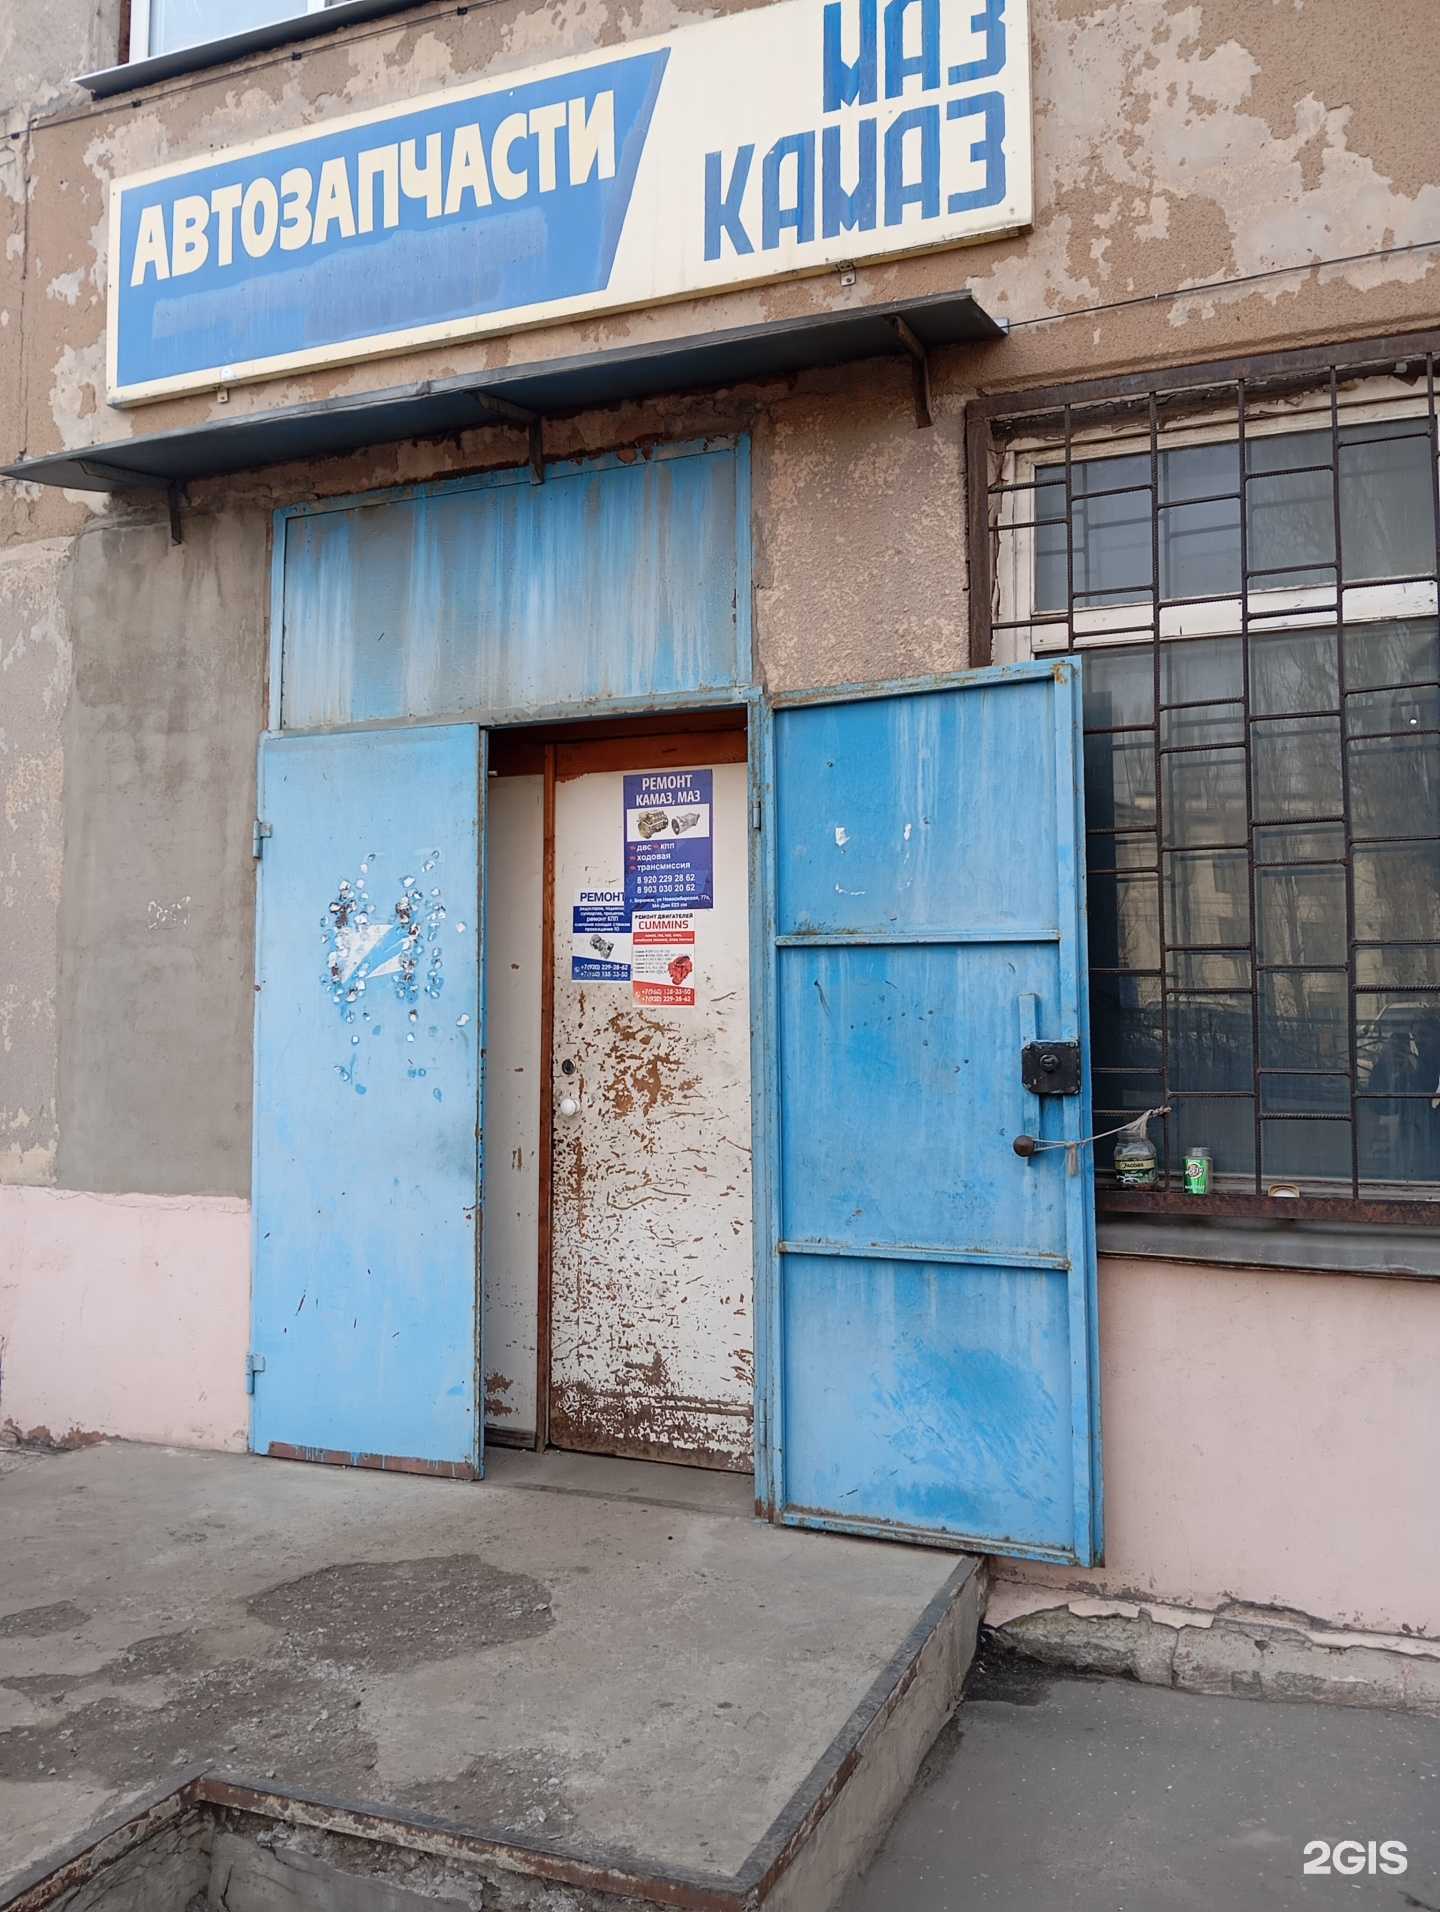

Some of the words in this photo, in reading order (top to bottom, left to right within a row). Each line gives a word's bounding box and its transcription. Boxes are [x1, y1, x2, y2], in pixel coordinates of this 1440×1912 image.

[703, 90, 1007, 262] КАМАЗ
[129, 89, 616, 287] АВТОЗАПЧАСТИ
[642, 774, 693, 791] РЕМОНТ
[636, 792, 675, 806] КАМАЗ,
[677, 790, 701, 804] МАЗ
[637, 853, 671, 861] ходовая
[637, 862, 691, 873] трансмиссия
[637, 876, 642, 884] 8
[643, 875, 657, 884] 920
[658, 874, 673, 883] 229
[674, 874, 684, 882] 28
[685, 873, 696, 881] 62
[637, 886, 642, 894] 8
[674, 884, 684, 892] 20
[685, 883, 696, 892] 62
[638, 920, 689, 930] CUMMINS
